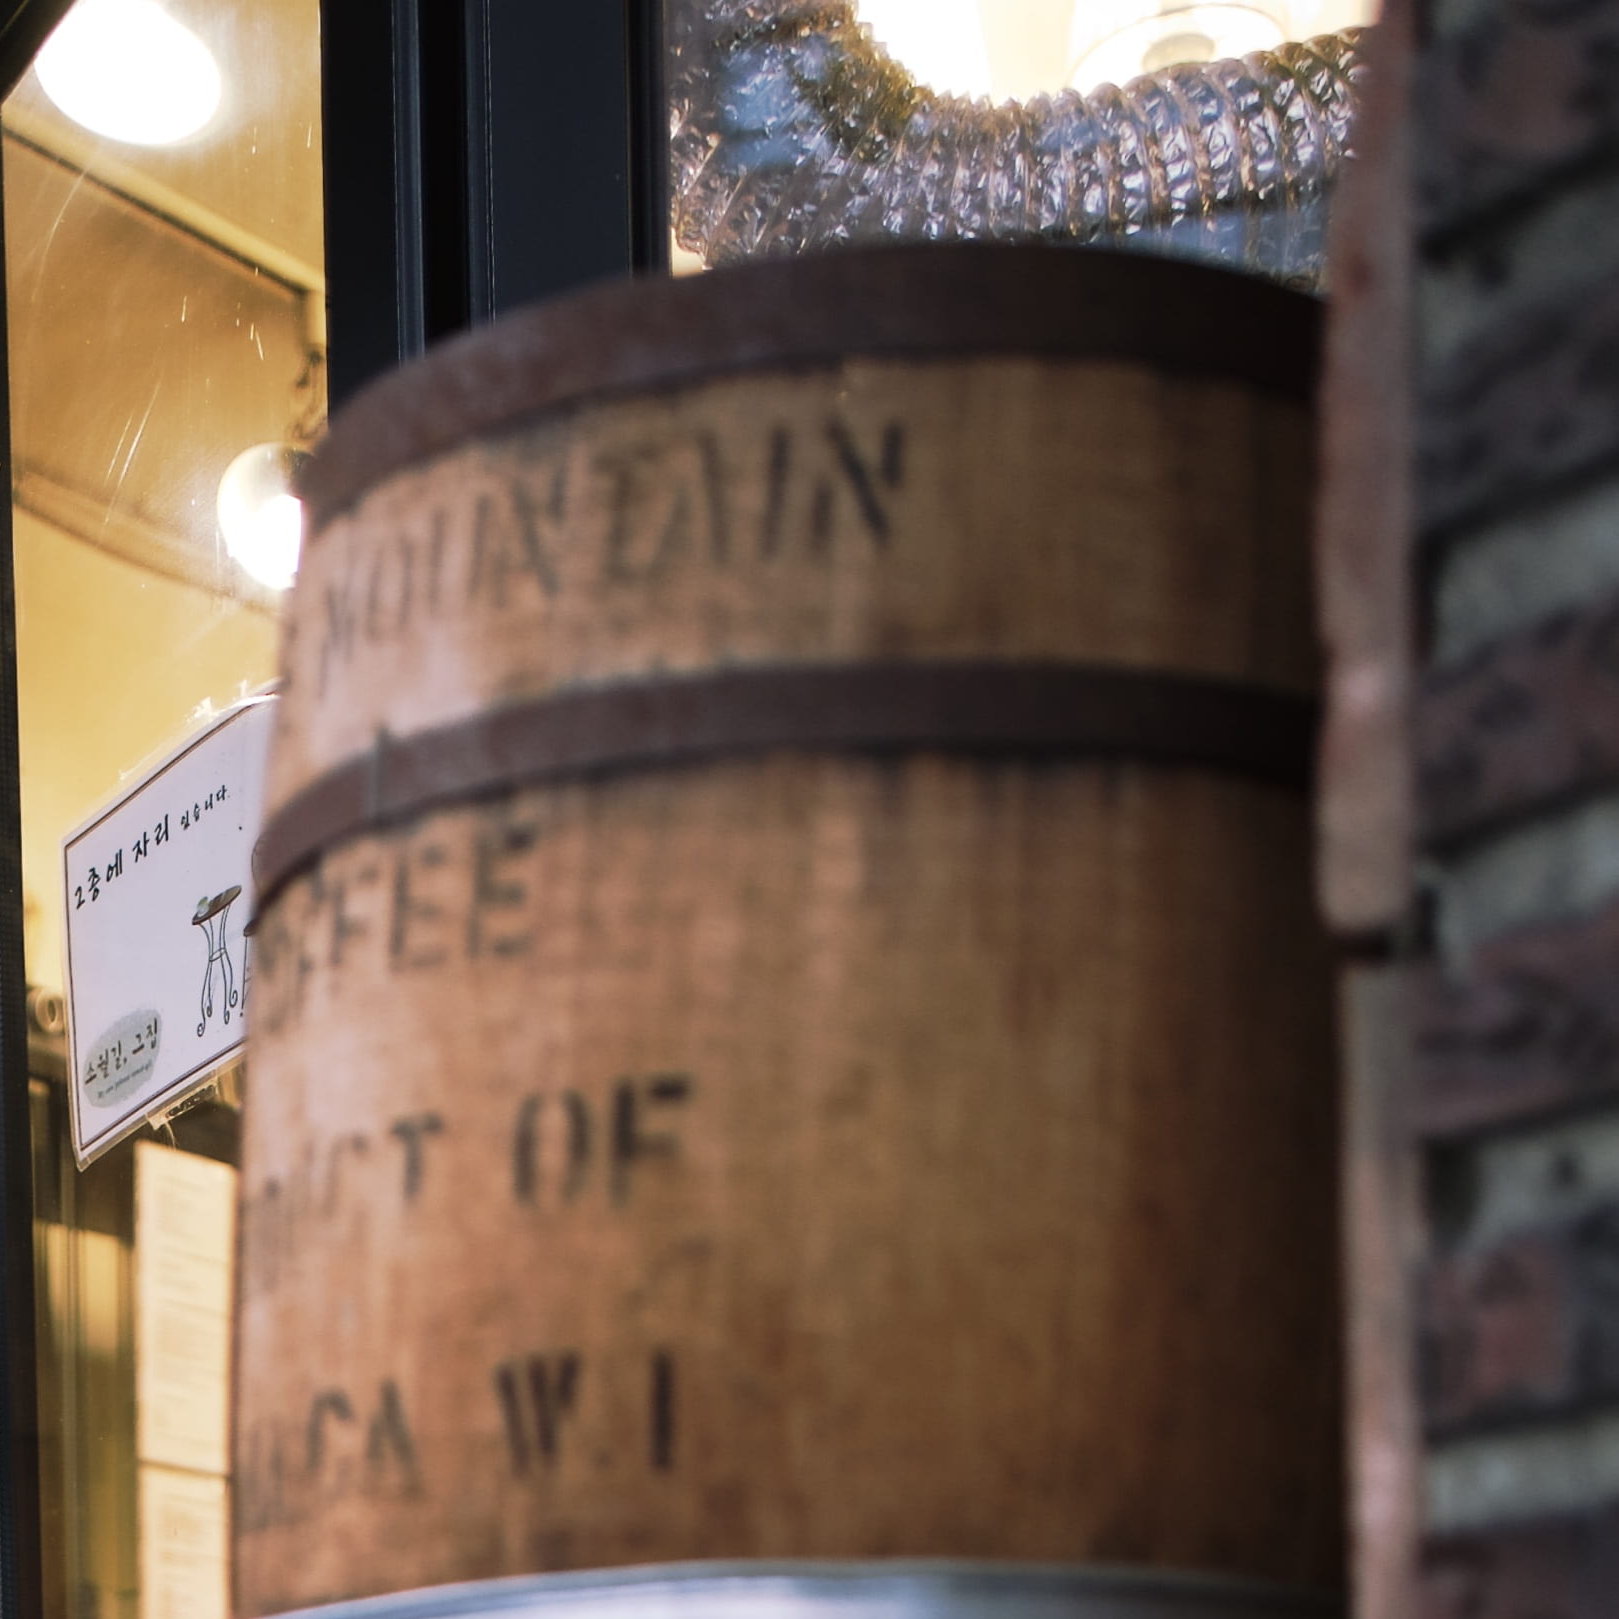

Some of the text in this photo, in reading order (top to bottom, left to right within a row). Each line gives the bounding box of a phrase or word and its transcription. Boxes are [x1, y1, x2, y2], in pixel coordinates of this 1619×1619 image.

[74, 849, 123, 910] 2층에
[132, 814, 169, 863] 자리
[132, 1017, 157, 1055] 그집
[513, 1071, 693, 1208] OF
